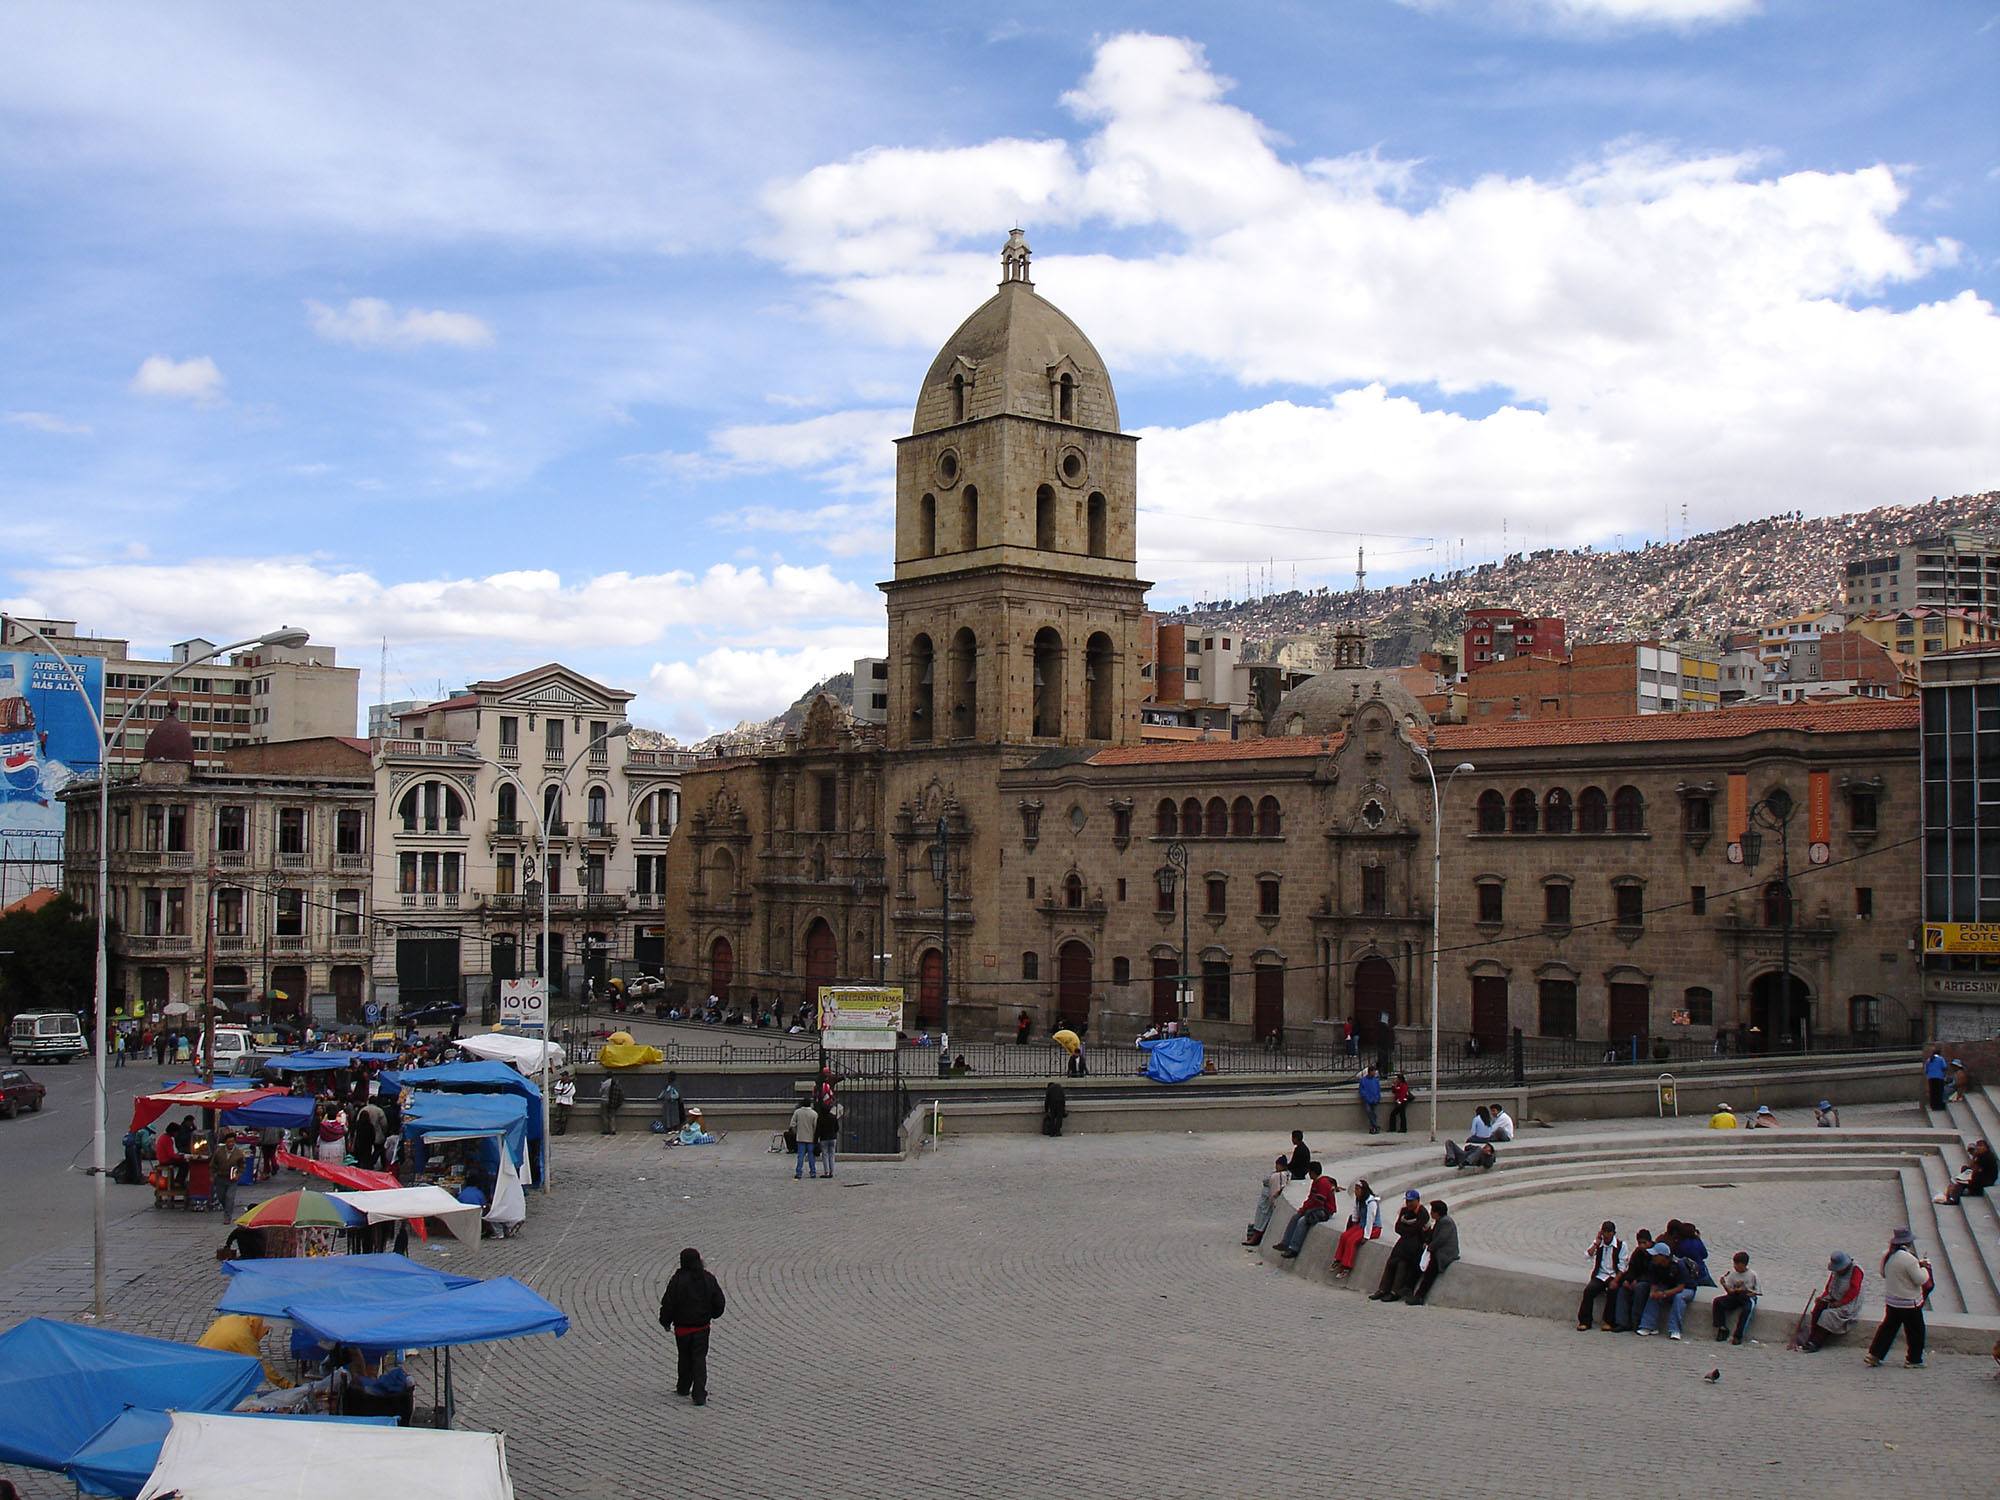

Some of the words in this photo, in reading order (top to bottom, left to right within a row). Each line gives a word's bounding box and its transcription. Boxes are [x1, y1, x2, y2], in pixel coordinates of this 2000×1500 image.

[33, 661, 87, 672] ATRÉVTE
[1960, 924, 2000, 932] PUNT
[503, 996, 520, 1008] 10
[521, 996, 542, 1009] 10
